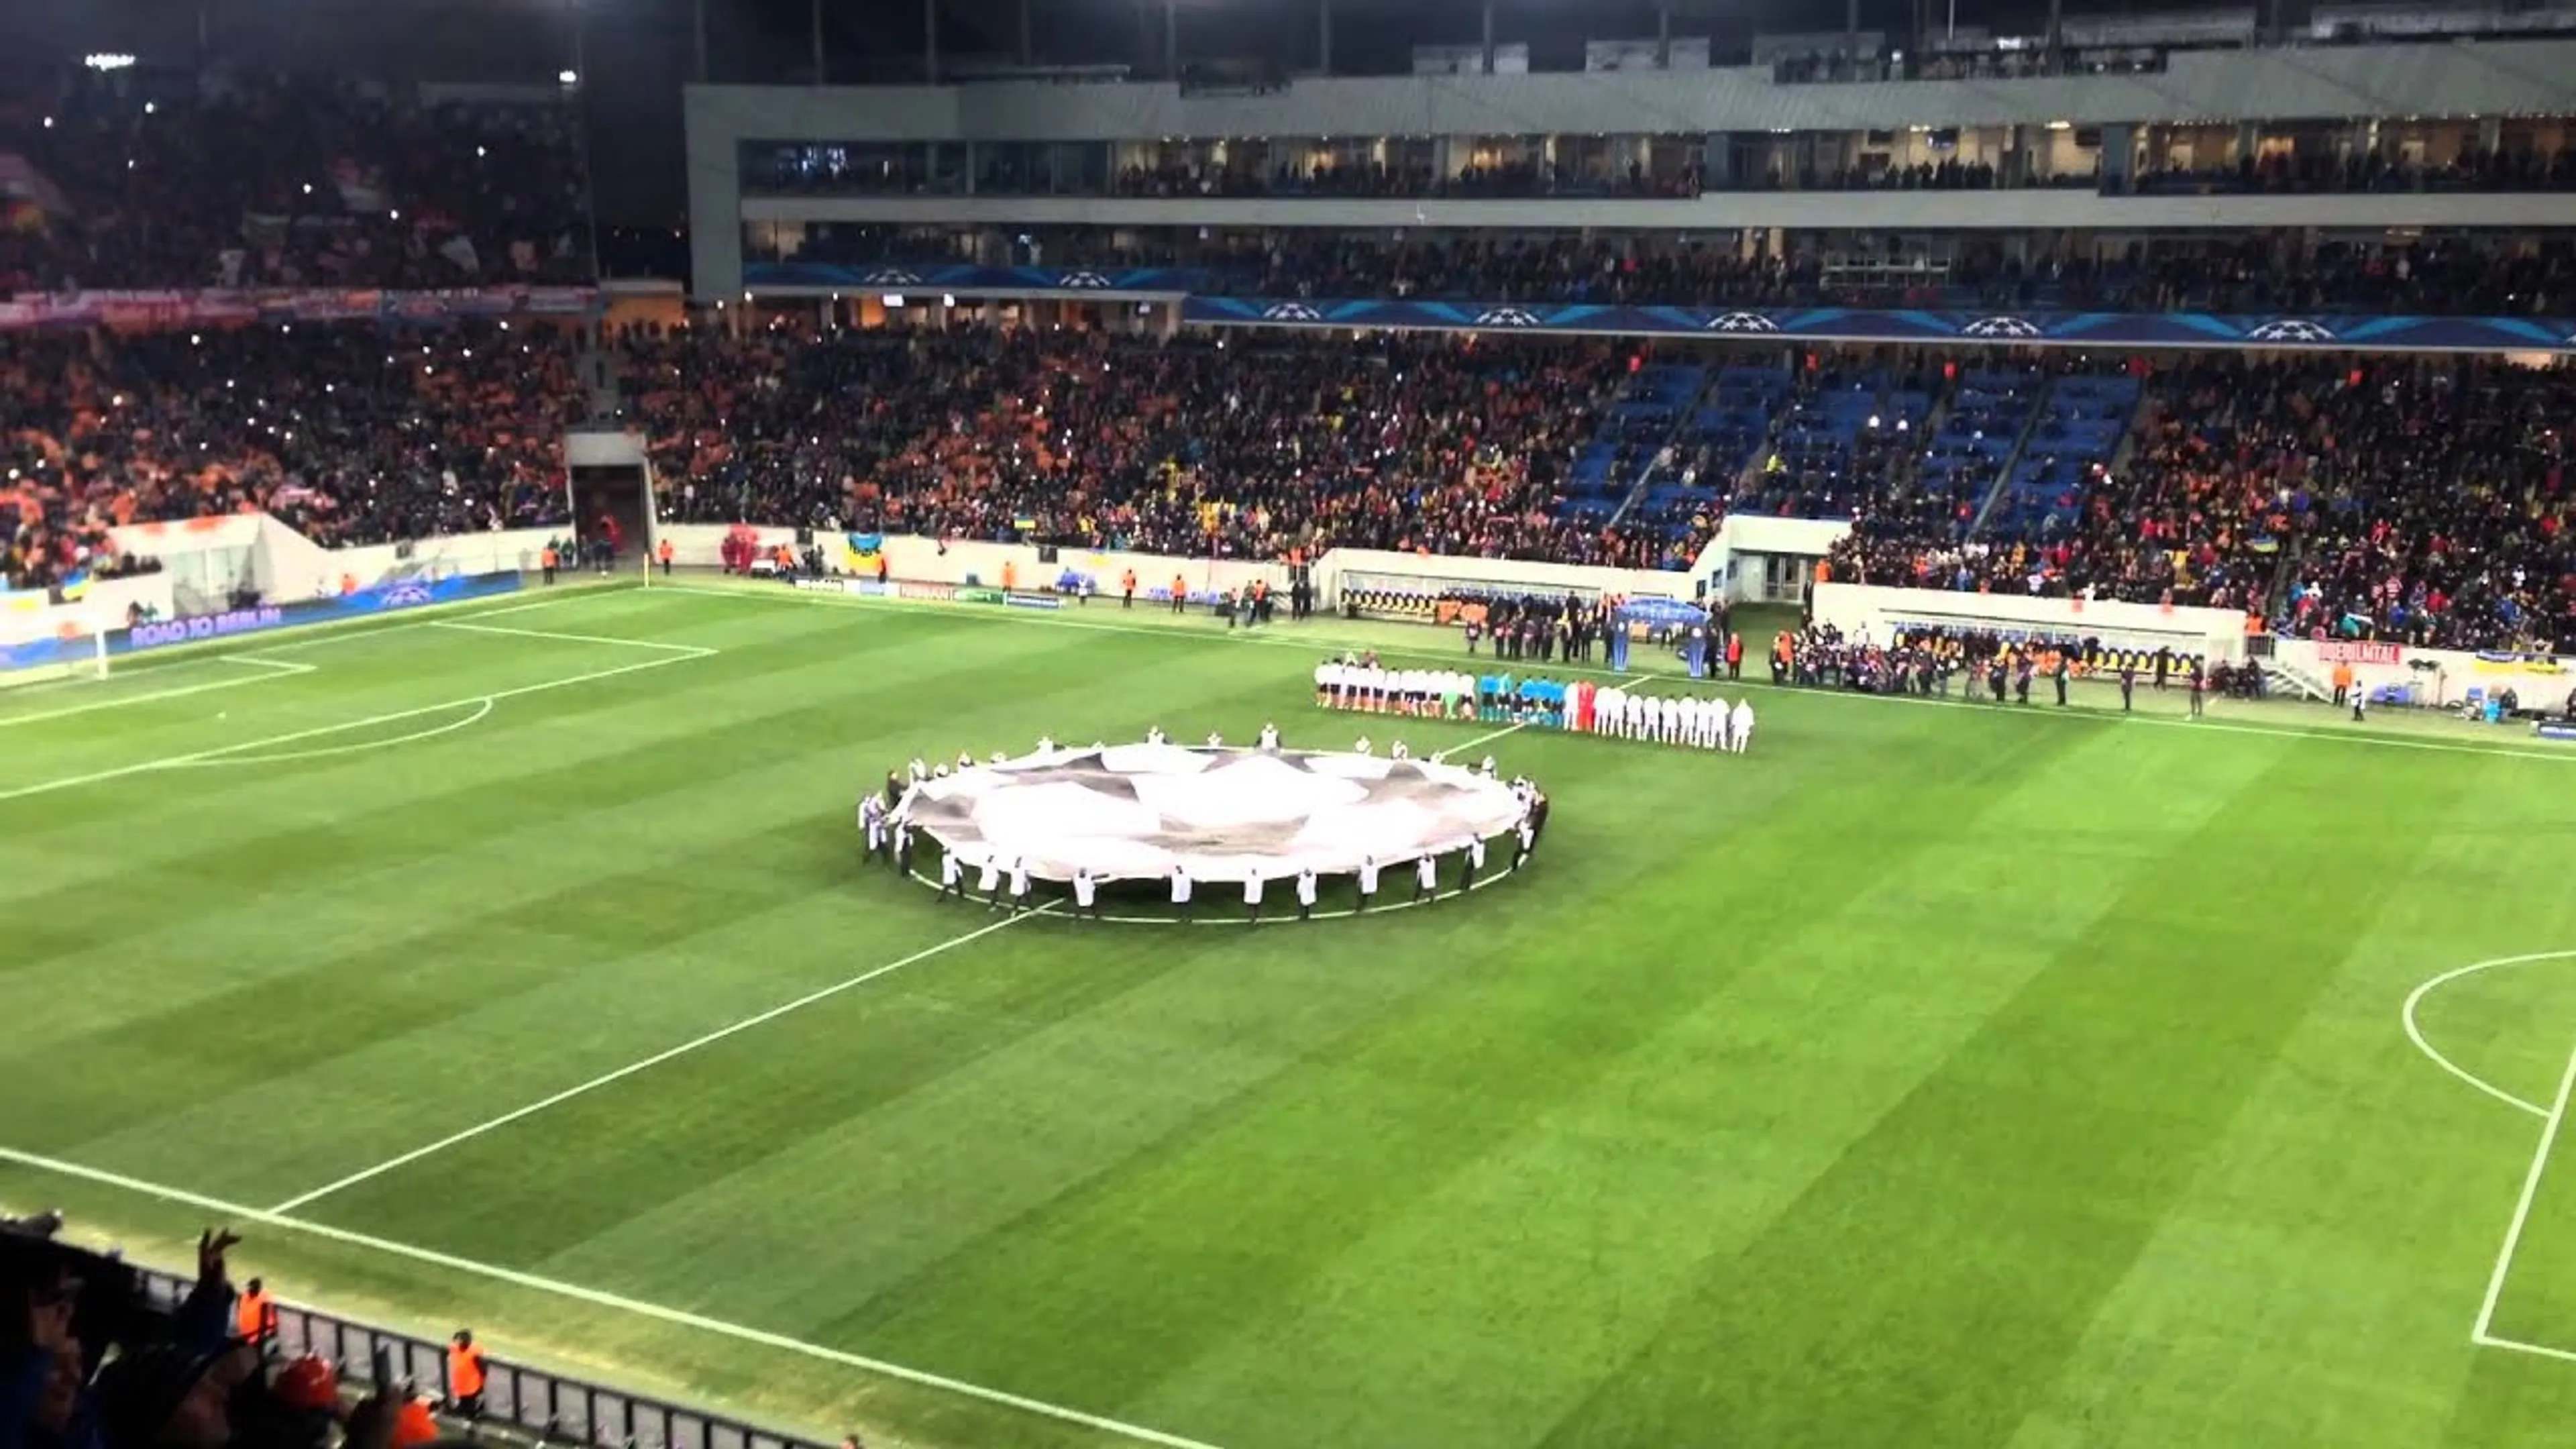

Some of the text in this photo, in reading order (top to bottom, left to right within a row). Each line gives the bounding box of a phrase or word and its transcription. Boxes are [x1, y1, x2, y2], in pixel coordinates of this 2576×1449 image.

[131, 608, 282, 647] ROAD TO BERLIN
